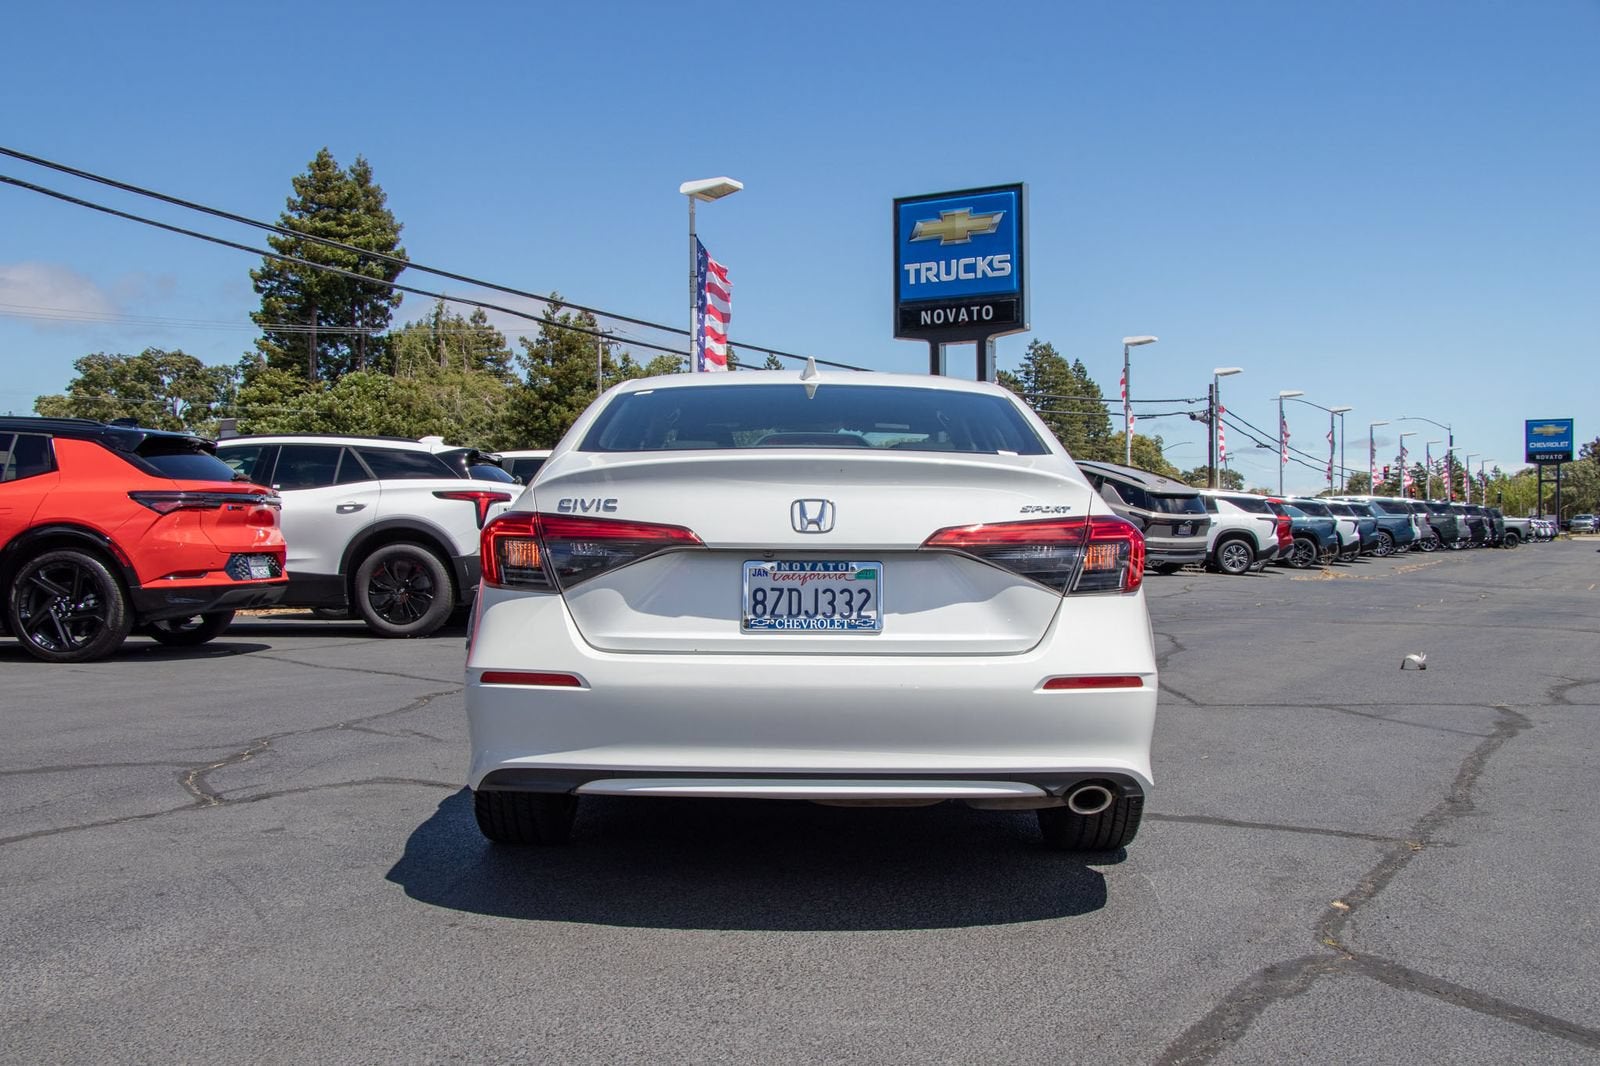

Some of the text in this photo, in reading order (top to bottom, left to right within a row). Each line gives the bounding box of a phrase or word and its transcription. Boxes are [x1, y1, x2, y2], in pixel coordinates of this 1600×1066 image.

[904, 254, 1012, 285] TRUCKS
[920, 305, 994, 325] NOVATO
[557, 498, 618, 513] CIVIC
[1020, 505, 1071, 514] SPORT
[752, 568, 768, 577] JAN
[781, 562, 846, 571] NOVATO
[752, 587, 872, 619] 8ZDJ332
[775, 618, 850, 629] CHEVROLET
